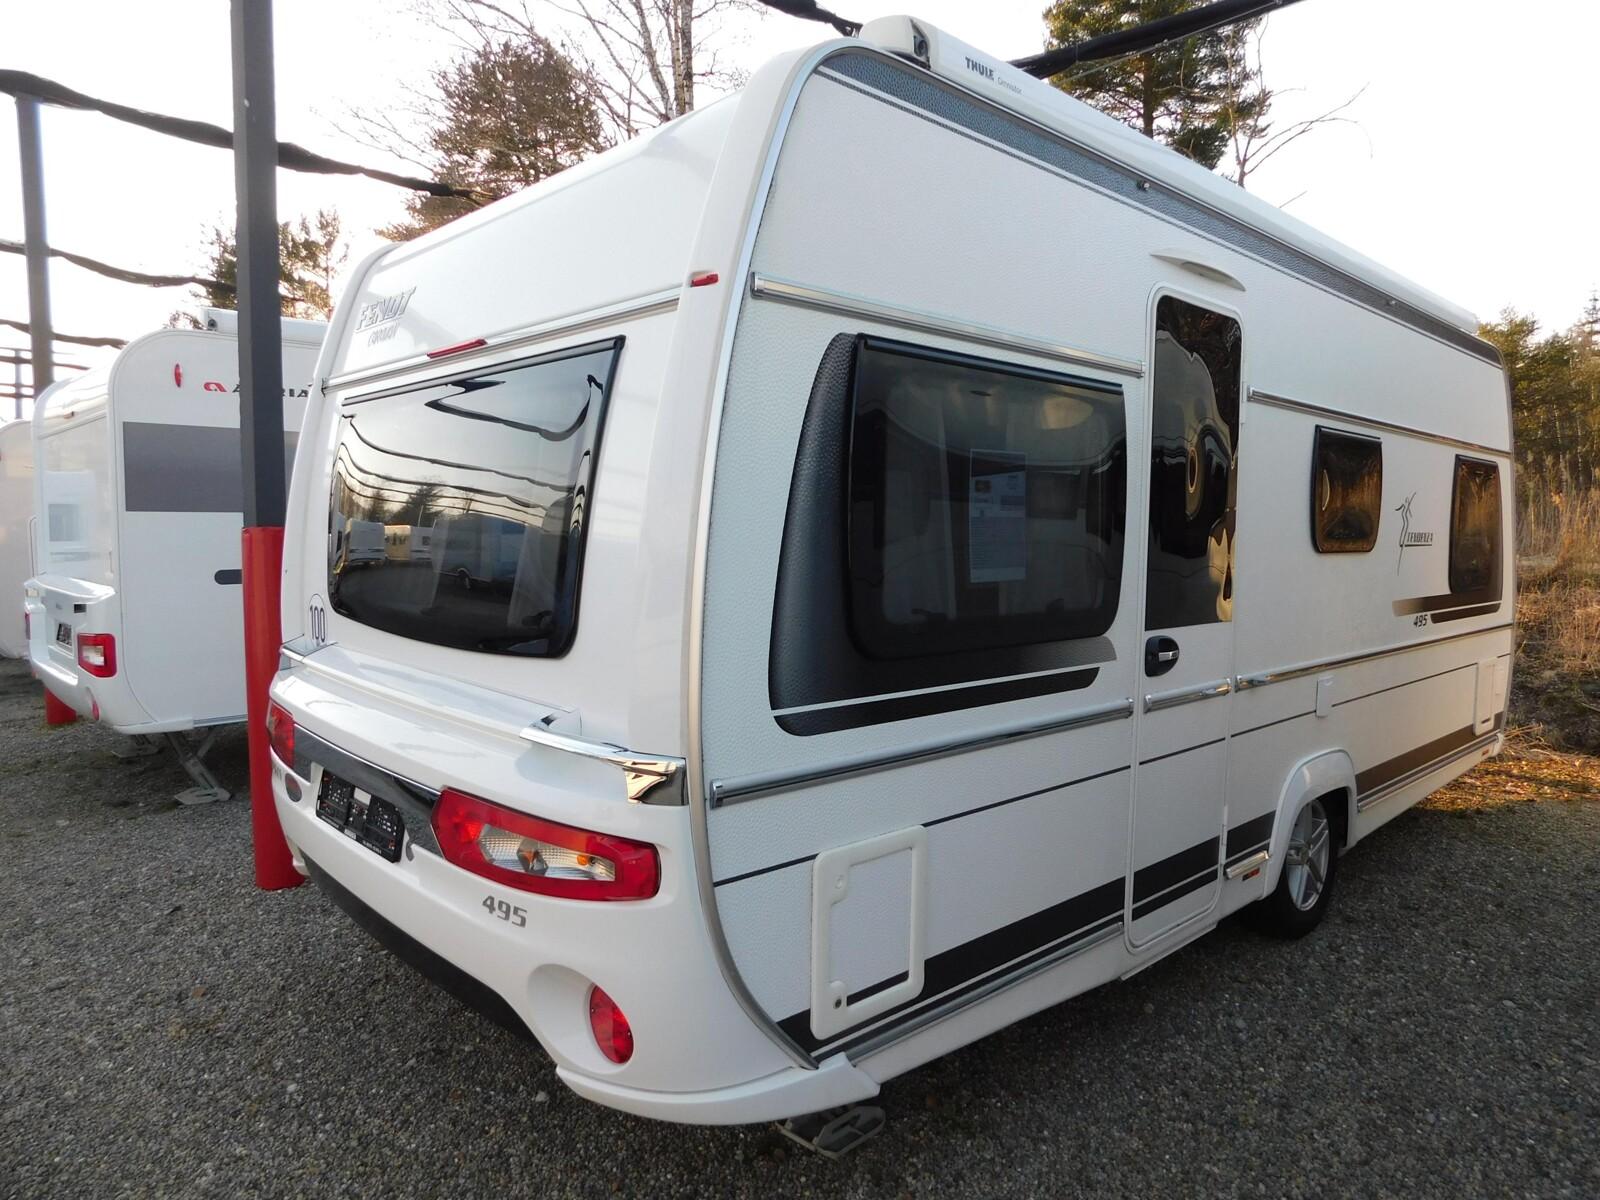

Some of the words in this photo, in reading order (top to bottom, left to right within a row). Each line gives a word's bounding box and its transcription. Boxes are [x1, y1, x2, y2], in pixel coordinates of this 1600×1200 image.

[965, 56, 995, 81] THULE
[355, 287, 417, 330] FENDT
[310, 605, 325, 643] 100
[1413, 614, 1428, 627] 495
[482, 895, 528, 928] 495
